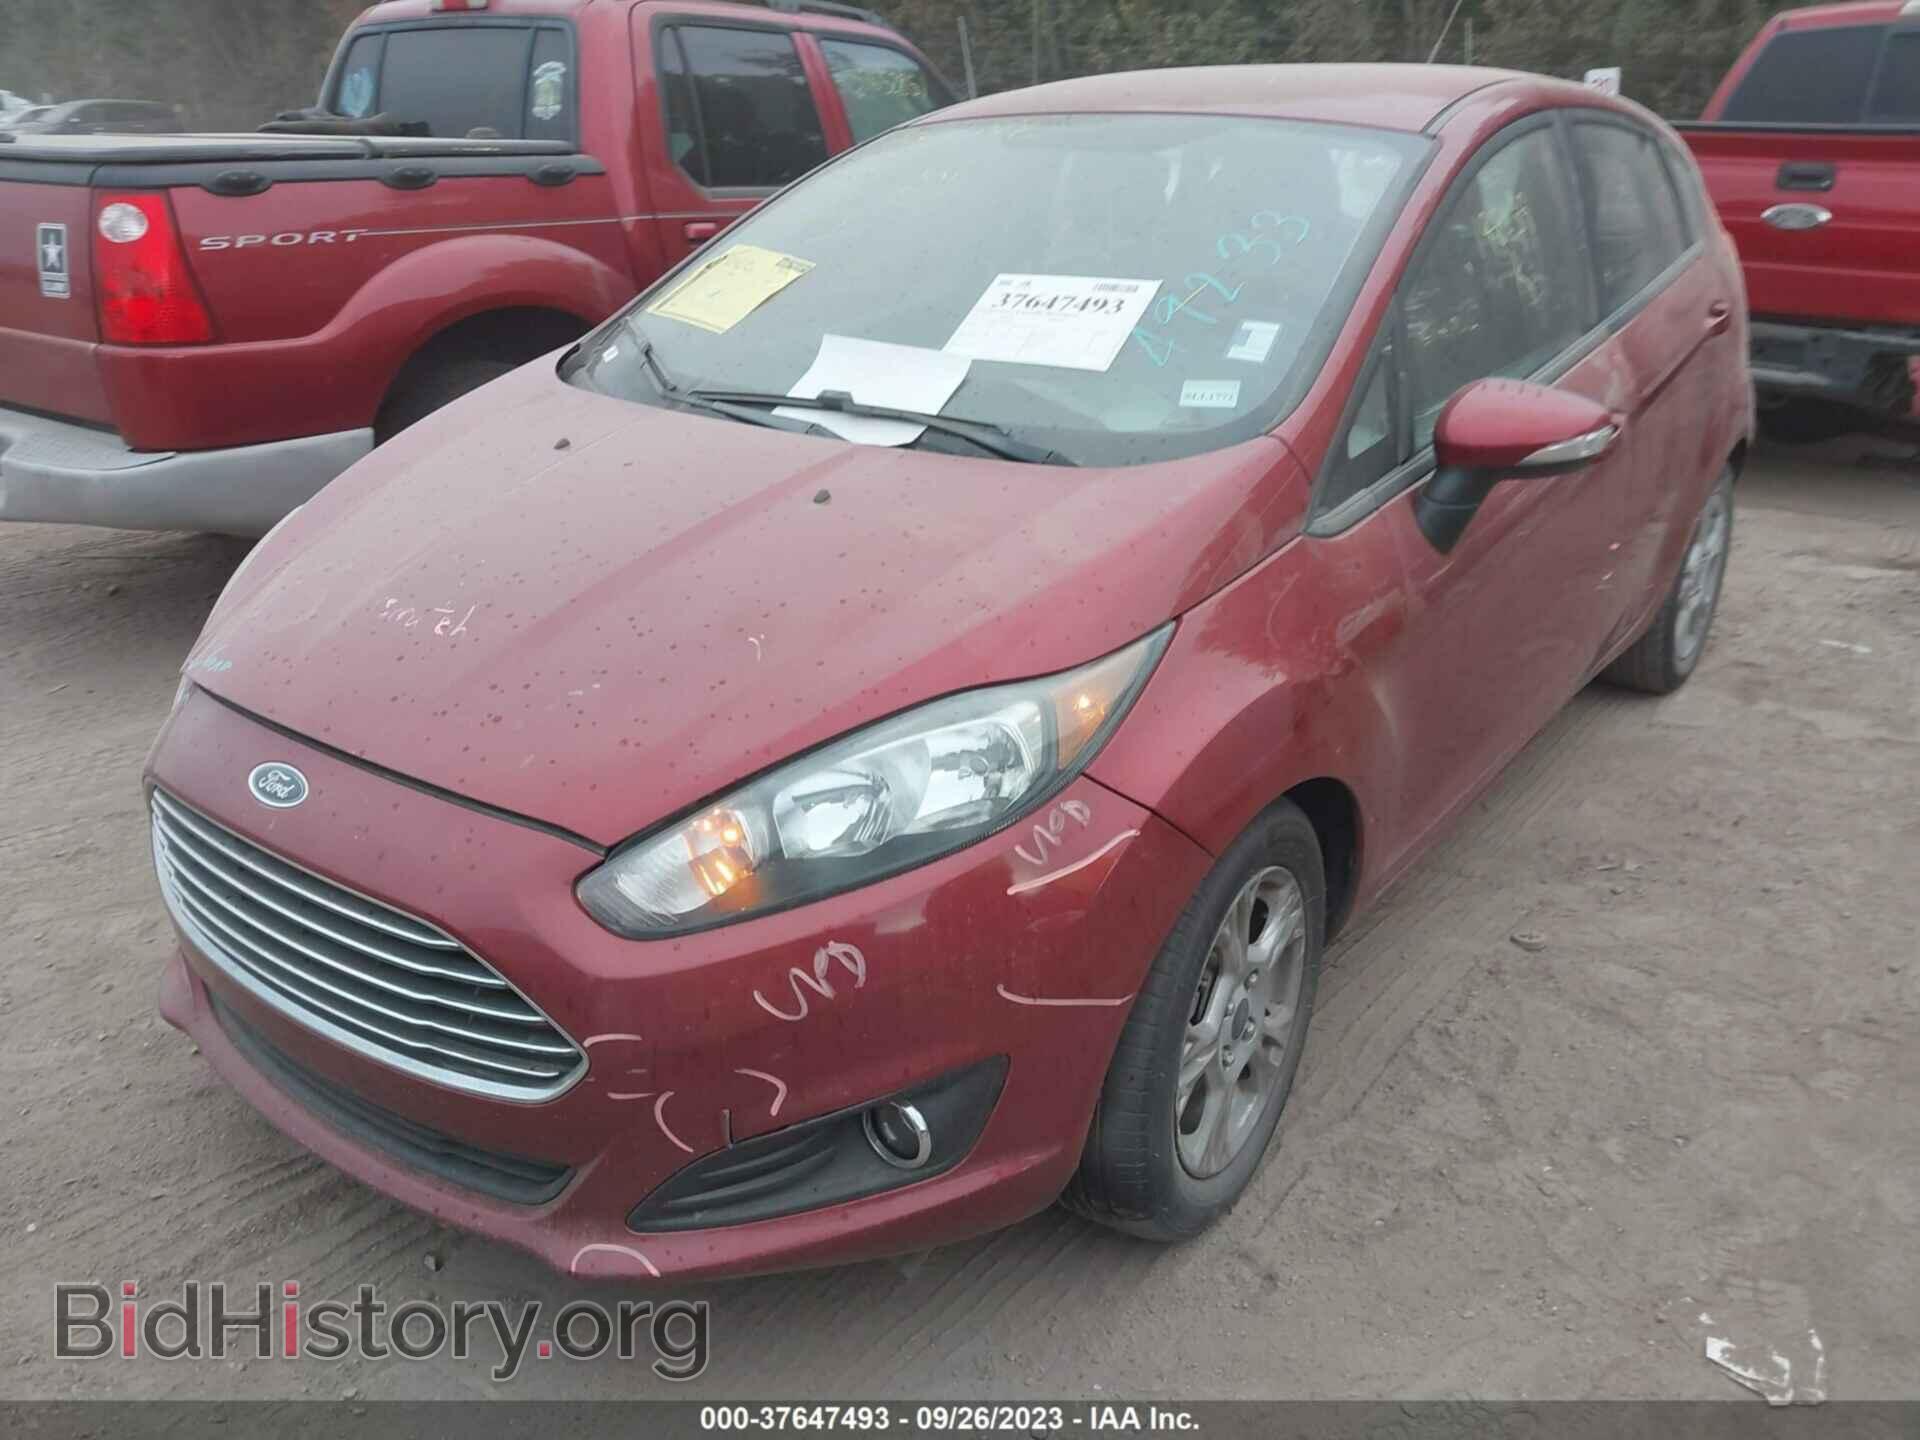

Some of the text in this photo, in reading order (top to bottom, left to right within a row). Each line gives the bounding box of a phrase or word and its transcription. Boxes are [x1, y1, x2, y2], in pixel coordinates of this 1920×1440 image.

[199, 228, 369, 251] SPORT
[991, 292, 1126, 315] 37647493
[258, 769, 296, 800] Ford
